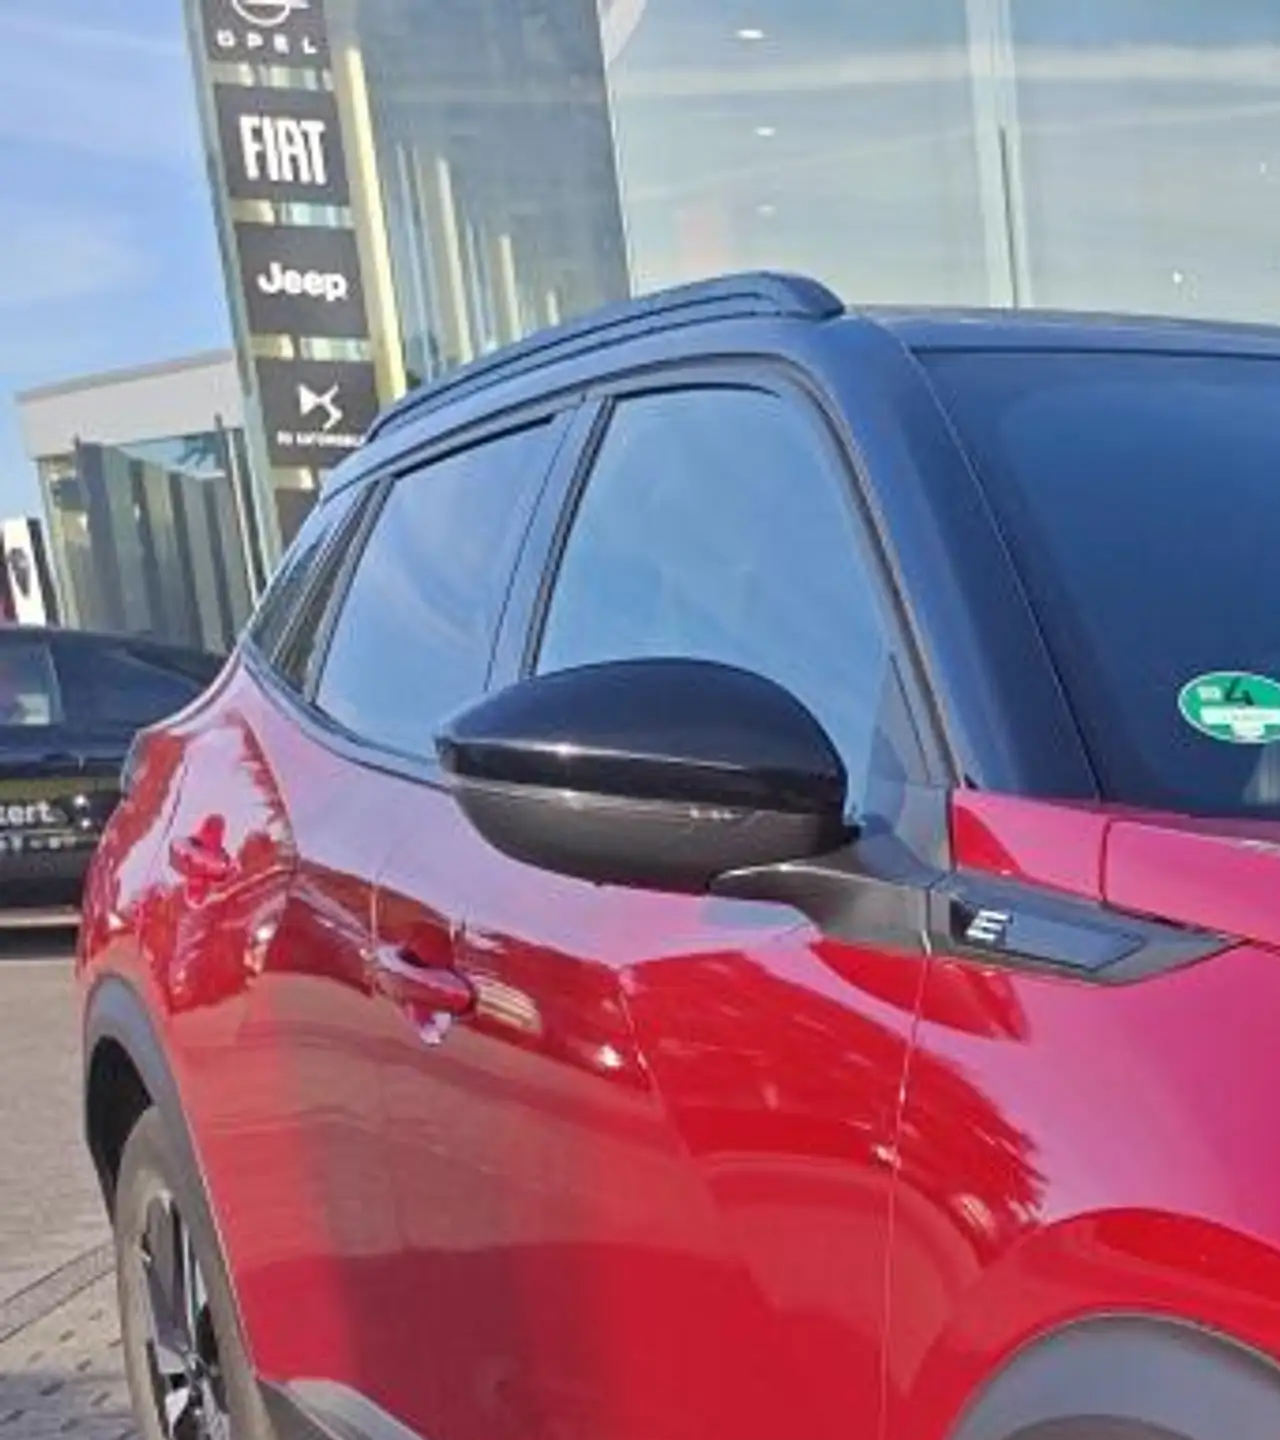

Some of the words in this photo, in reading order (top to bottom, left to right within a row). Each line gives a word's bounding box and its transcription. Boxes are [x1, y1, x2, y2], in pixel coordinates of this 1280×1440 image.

[216, 29, 318, 54] OPEL
[238, 113, 327, 185] FIAT
[256, 261, 348, 302] Jeep
